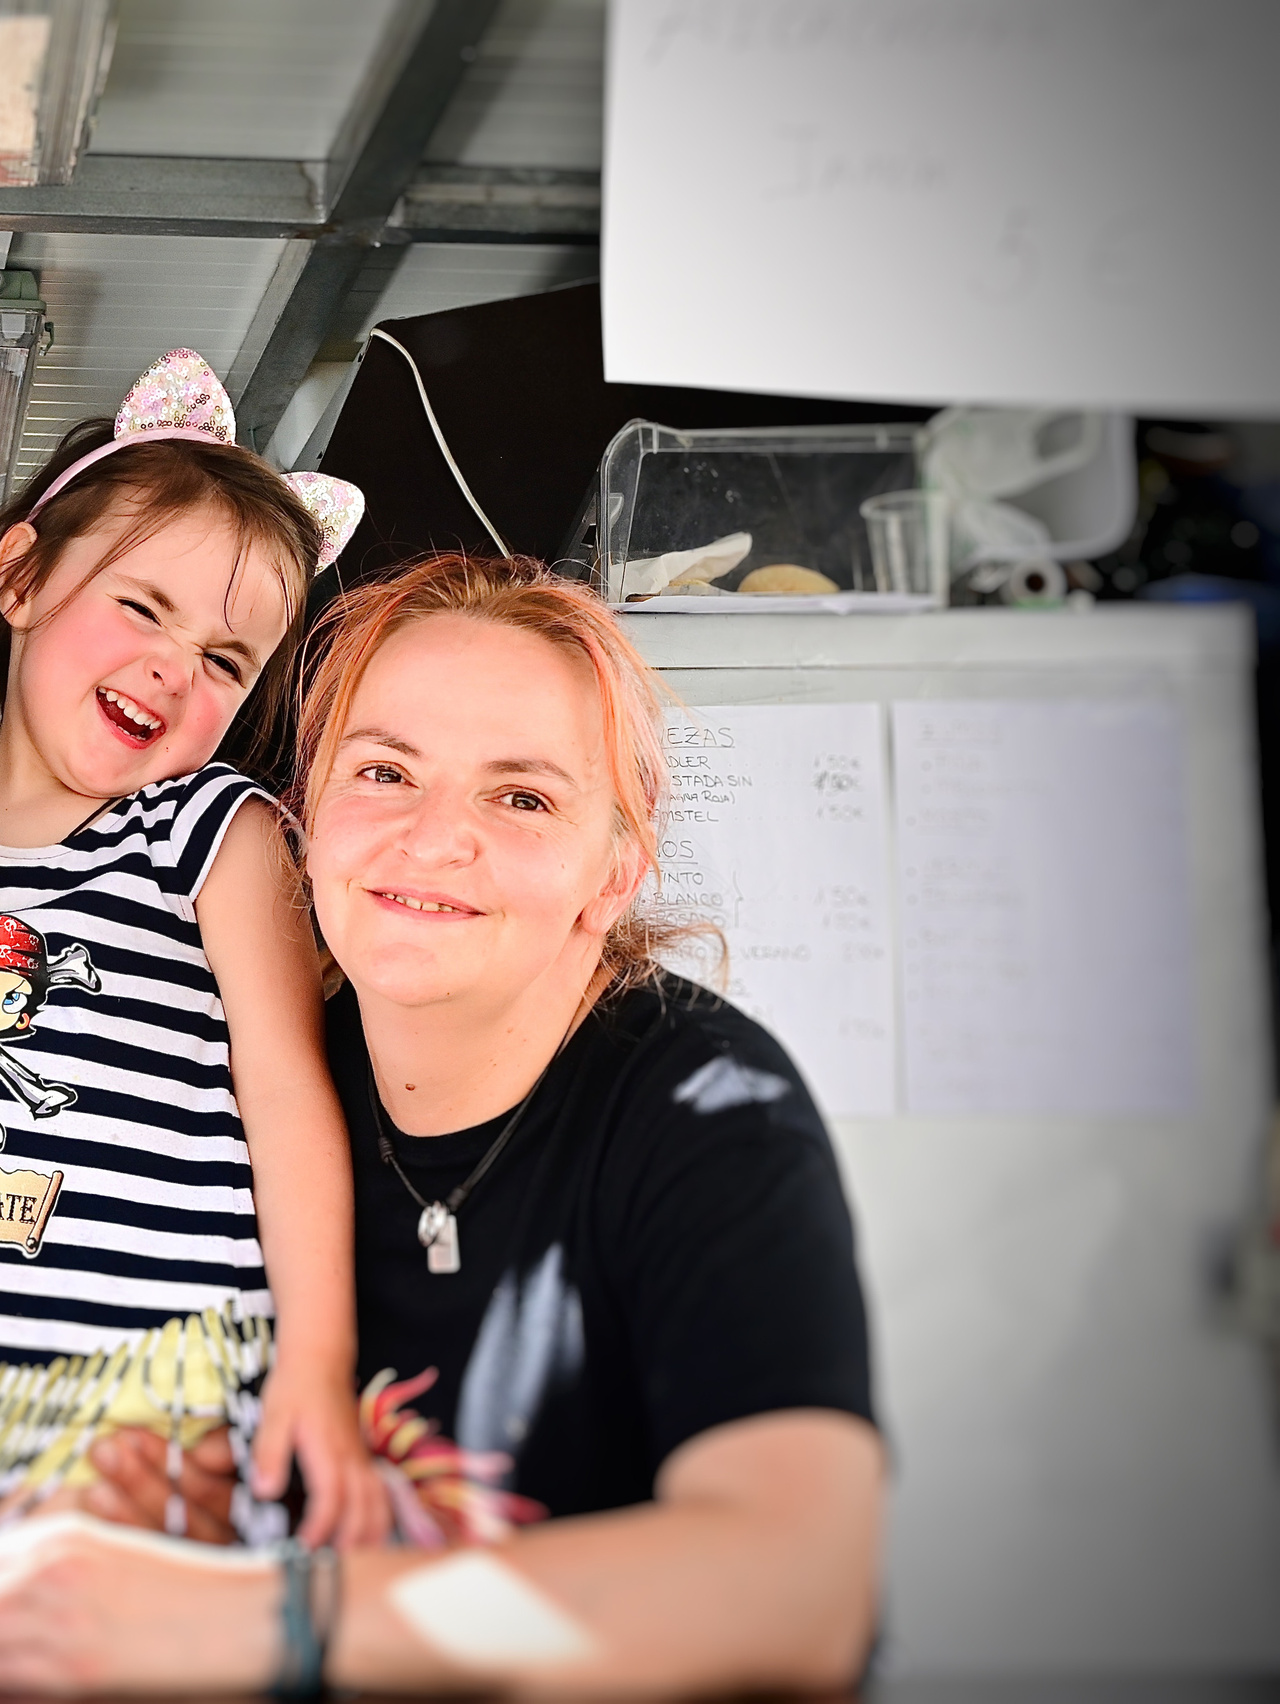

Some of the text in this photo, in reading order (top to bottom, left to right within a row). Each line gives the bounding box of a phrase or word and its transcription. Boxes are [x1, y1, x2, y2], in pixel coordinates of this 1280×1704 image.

[661, 727, 734, 748] EZAS
[665, 755, 711, 769] DLER
[671, 775, 724, 788] STADA
[727, 774, 753, 787] SIN
[653, 891, 724, 906] BLANCO
